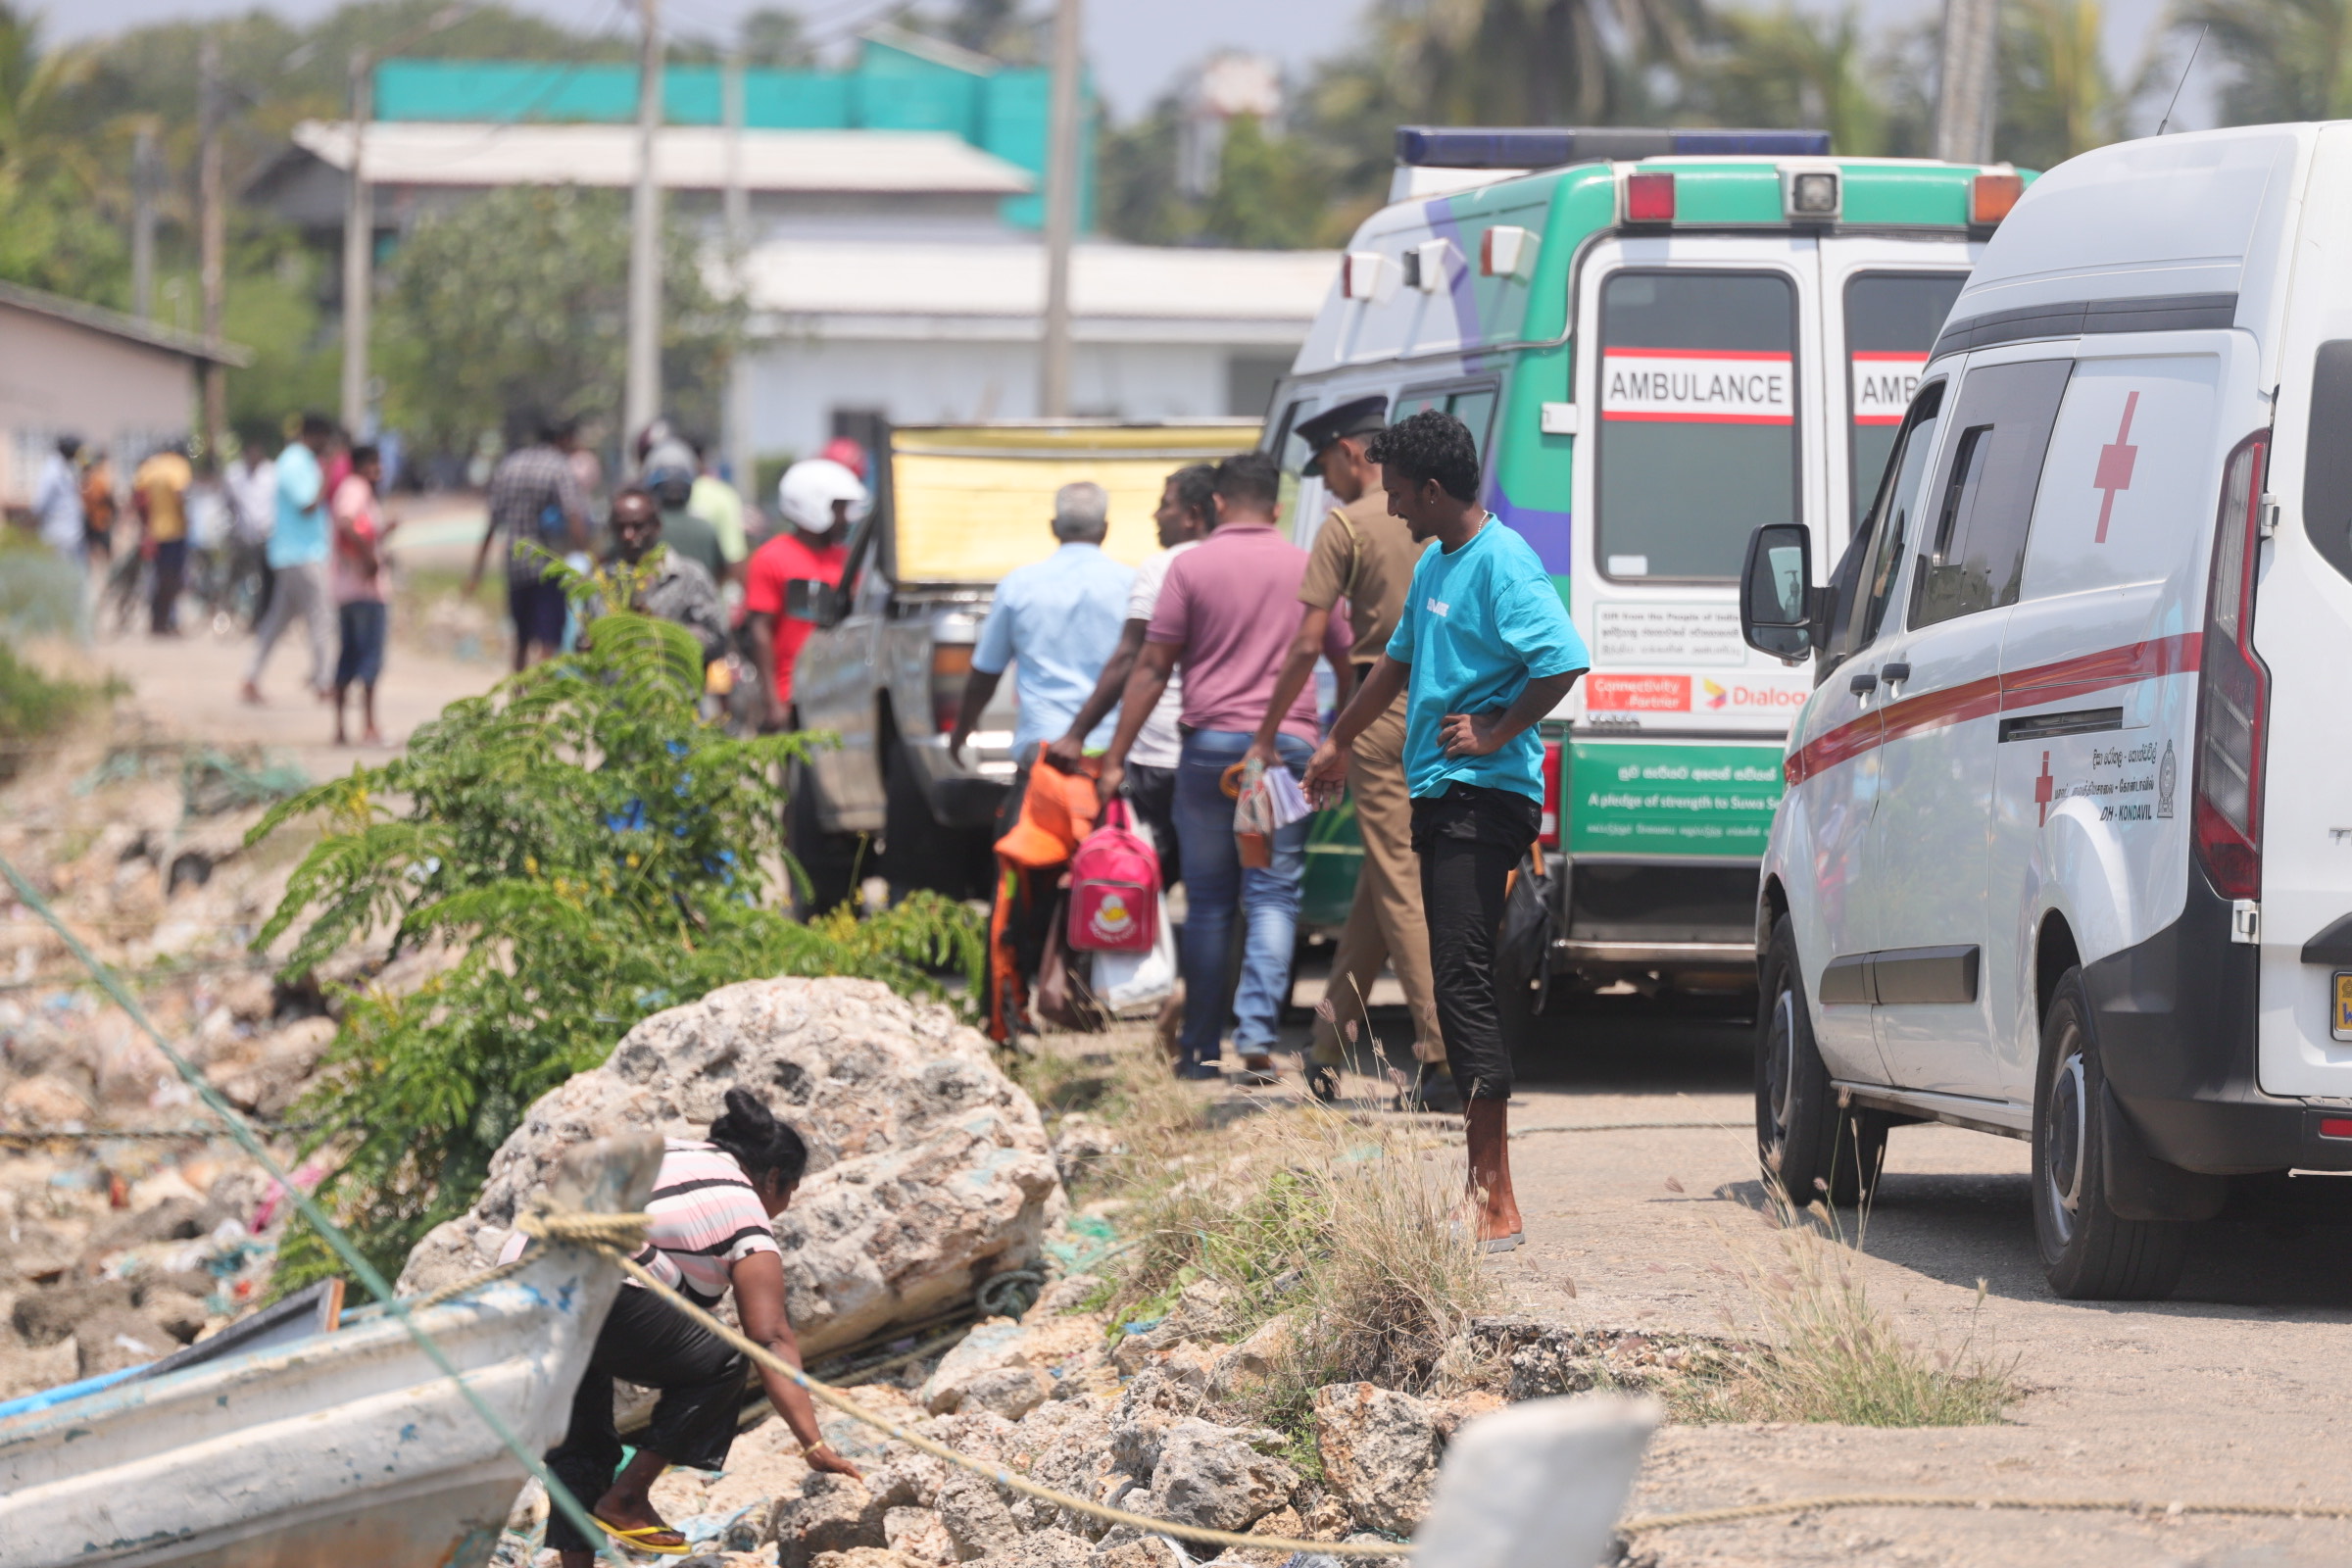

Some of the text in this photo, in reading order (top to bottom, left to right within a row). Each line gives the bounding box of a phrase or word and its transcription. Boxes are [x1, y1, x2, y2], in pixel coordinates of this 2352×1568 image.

[1610, 371, 1782, 404] AMBULANCE
[1594, 678, 1680, 694] Connectivity
[1629, 695, 1680, 709] Partner
[1588, 794, 1598, 807] A
[1600, 794, 1642, 809] pledge
[1644, 794, 1659, 807] of
[1660, 796, 1713, 810] strength
[1715, 797, 1728, 808] to
[1730, 796, 1764, 809] Suwa
[2099, 806, 2114, 821] DH
[2119, 805, 2152, 821] KONDAVIL
